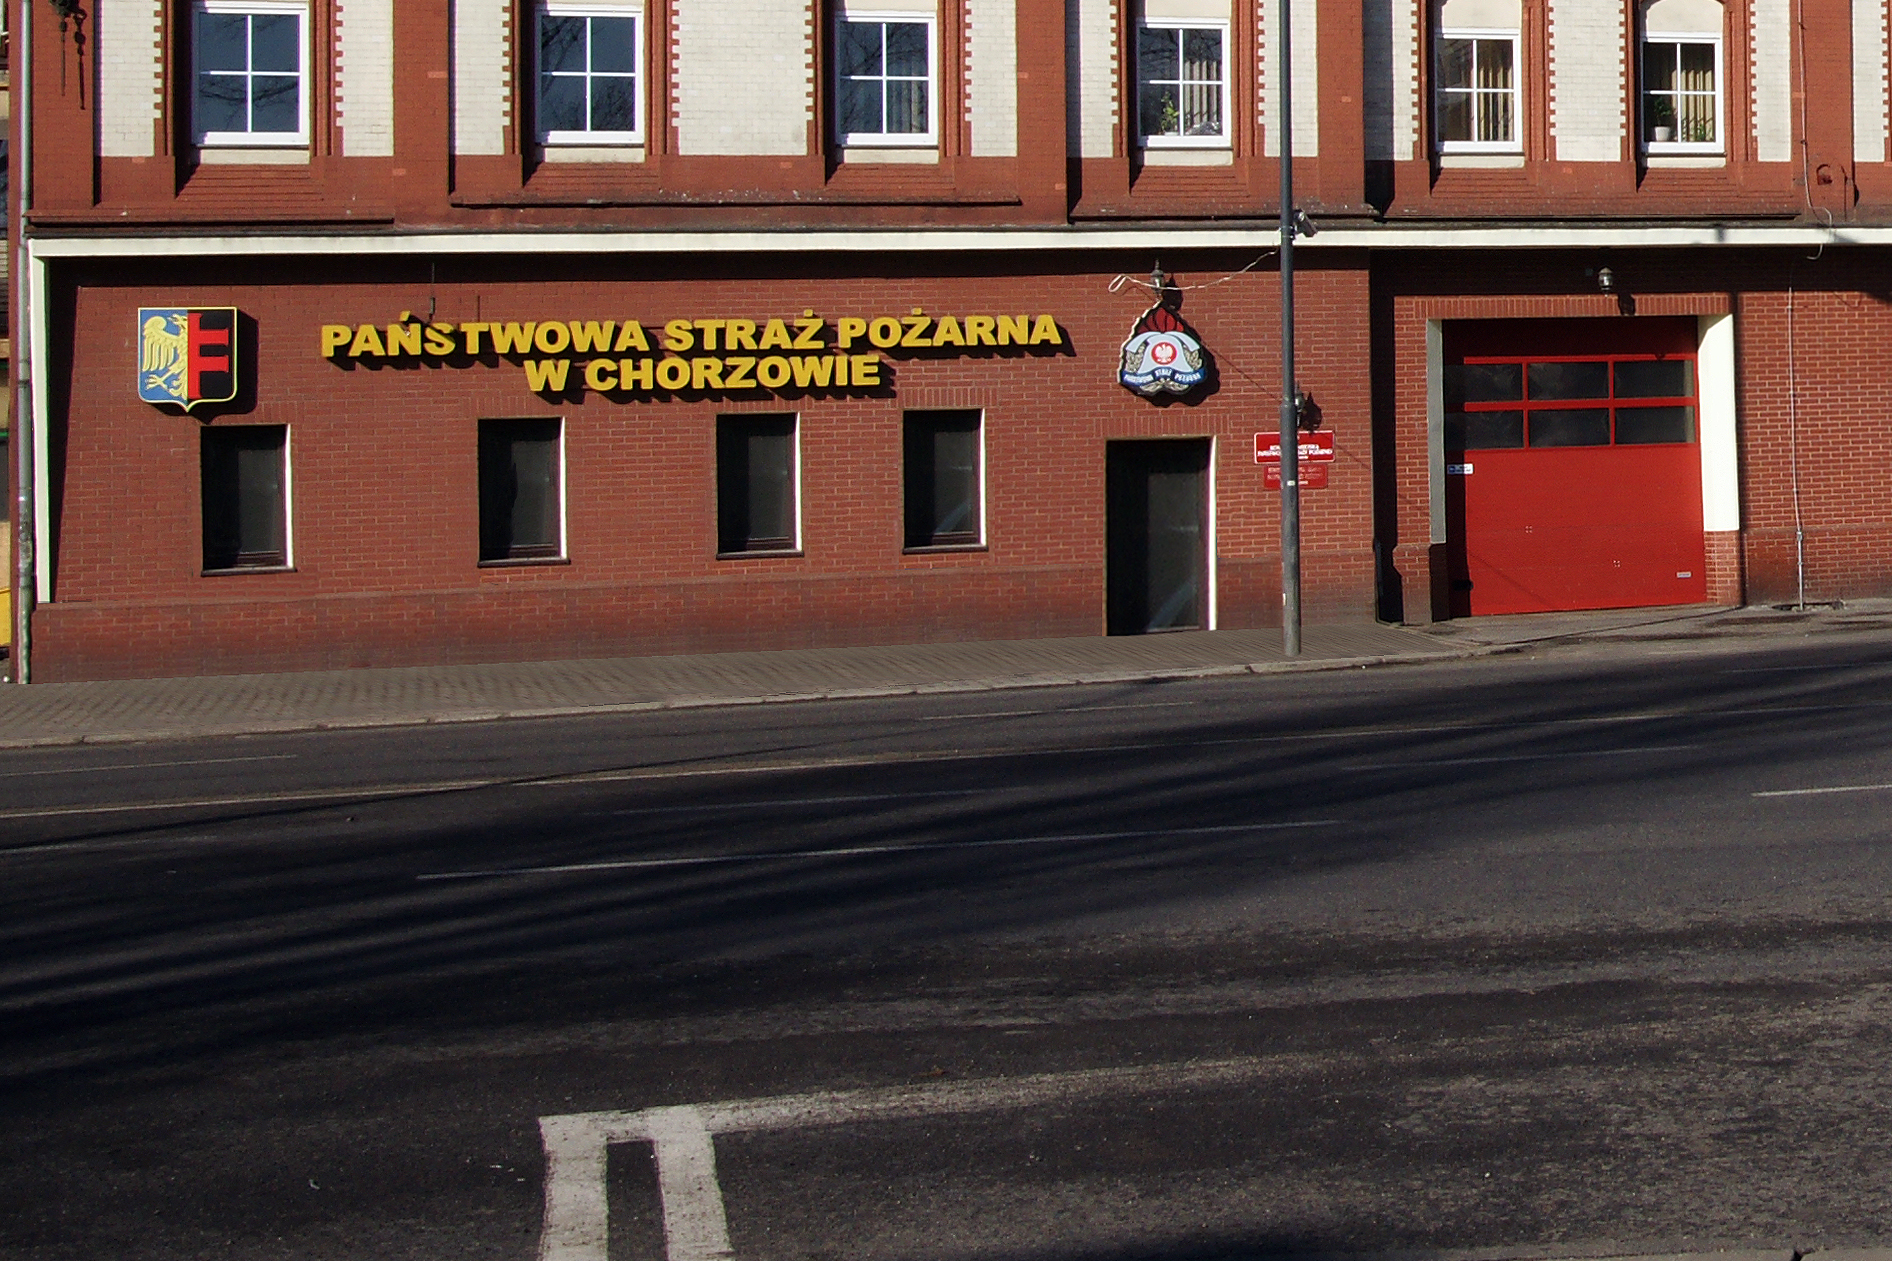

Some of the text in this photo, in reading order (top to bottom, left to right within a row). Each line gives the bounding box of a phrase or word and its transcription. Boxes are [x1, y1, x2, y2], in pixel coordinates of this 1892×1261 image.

[321, 307, 1062, 357] PAŃSTWOWA STRAŻ POŻARNA
[524, 355, 881, 392] W CHORZOWIE
